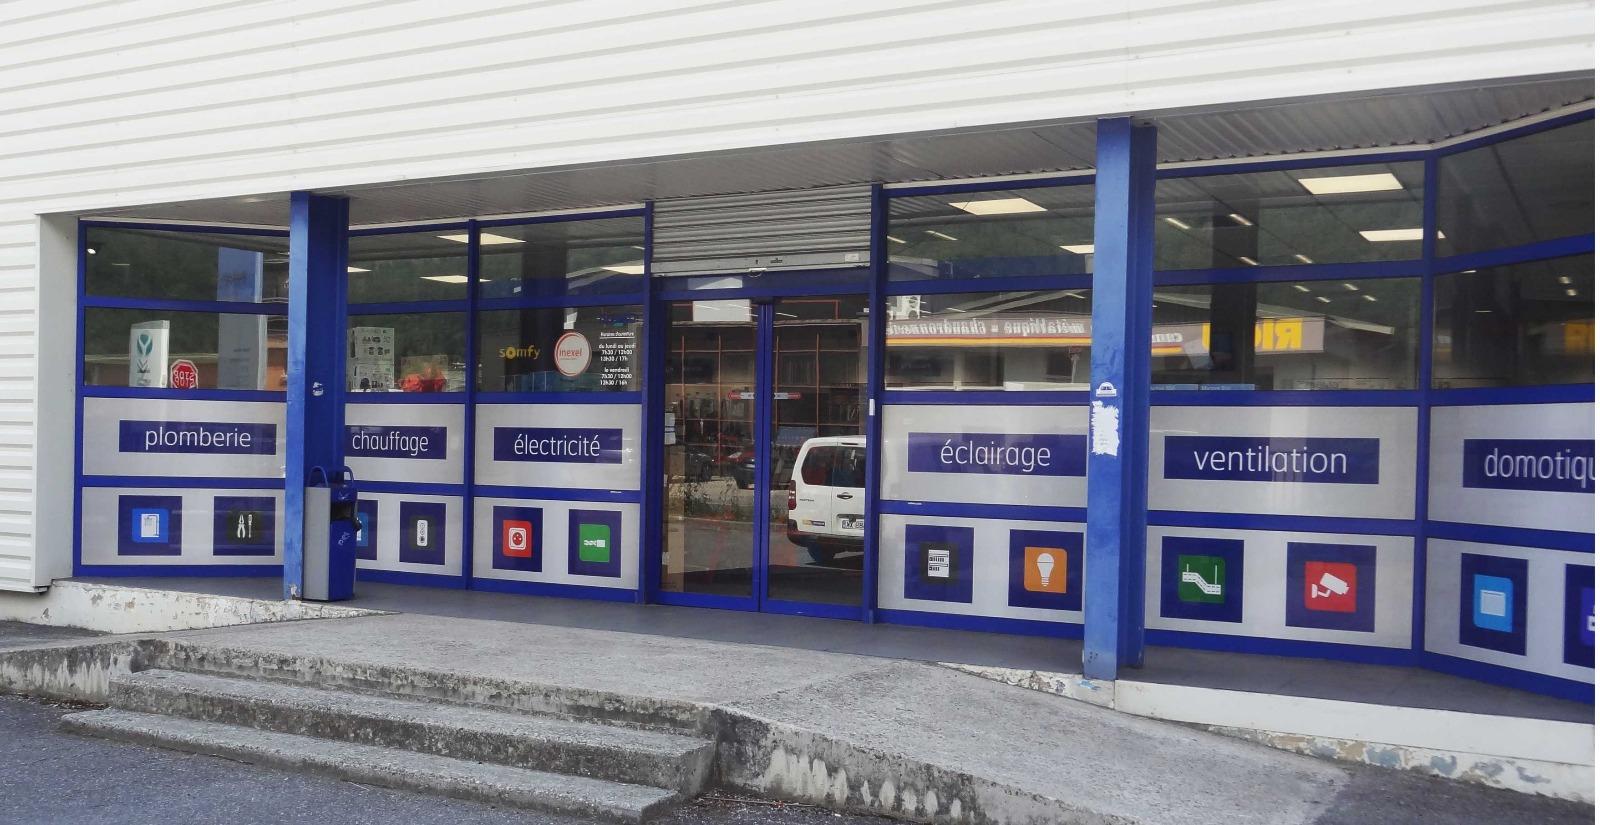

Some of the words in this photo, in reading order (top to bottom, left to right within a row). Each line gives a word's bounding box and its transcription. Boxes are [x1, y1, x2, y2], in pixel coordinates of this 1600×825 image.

[498, 344, 540, 360] somfy
[145, 426, 252, 451] plomberie
[352, 430, 429, 456] chauffage
[514, 433, 601, 457] électricité
[940, 438, 1051, 472] éclairage
[1193, 445, 1347, 474] ventilation
